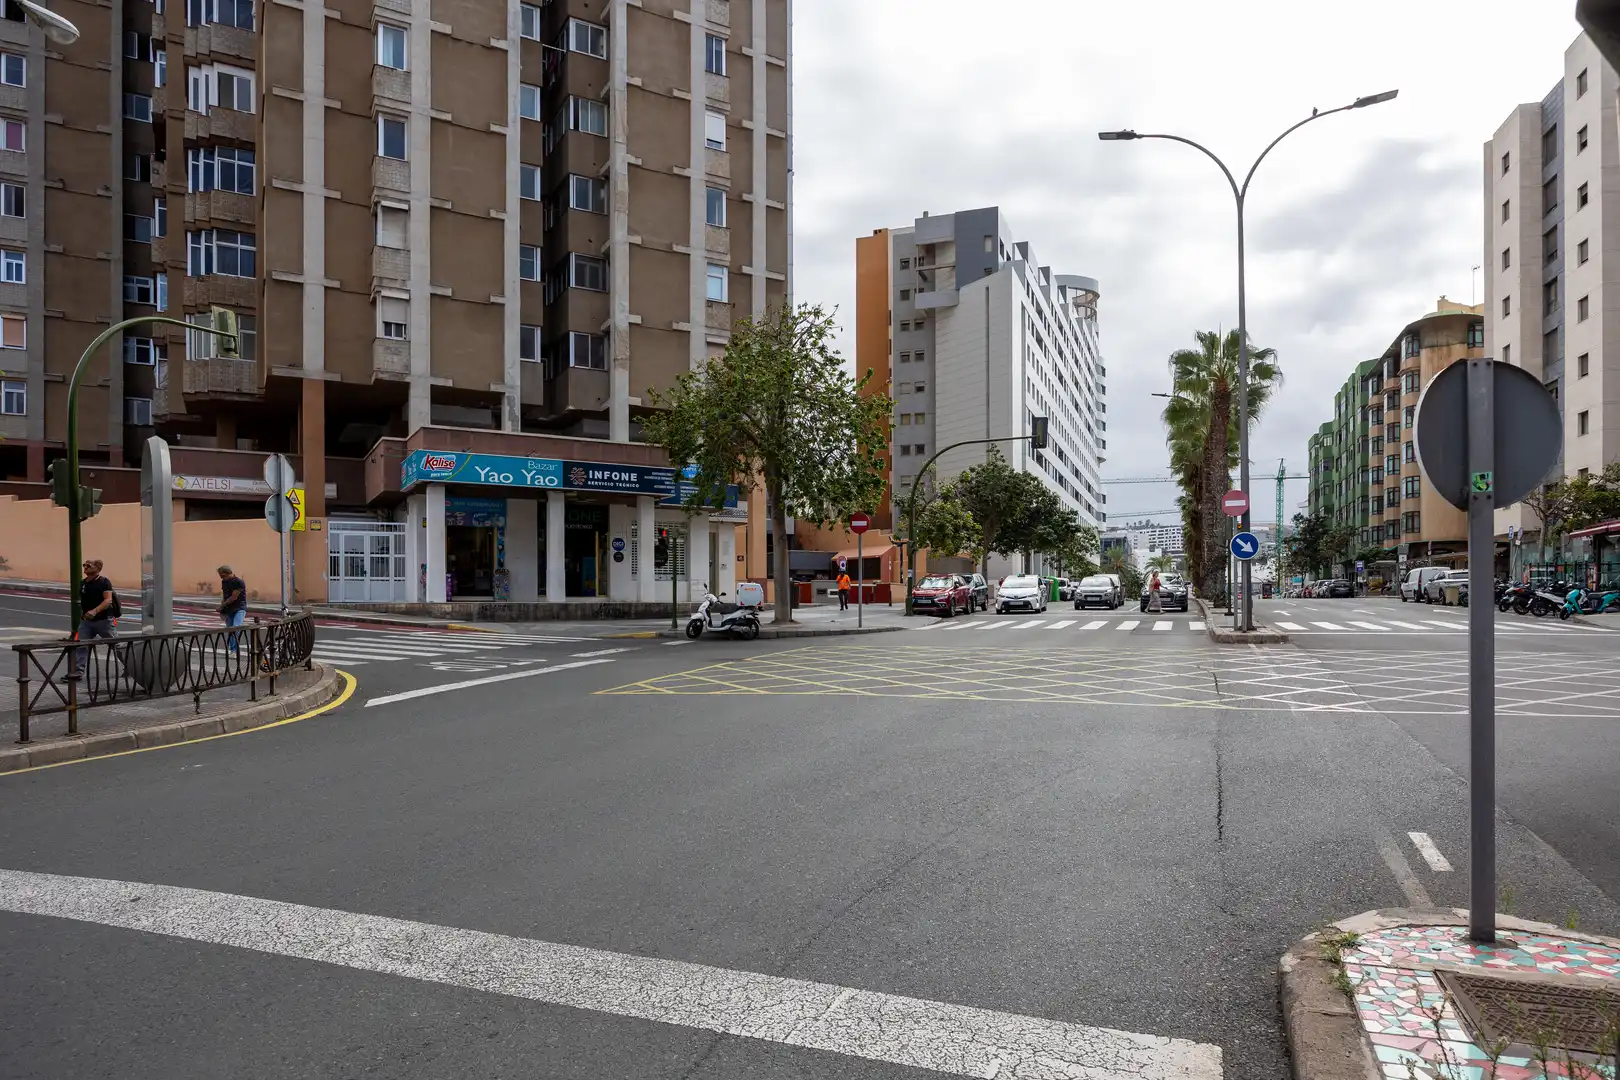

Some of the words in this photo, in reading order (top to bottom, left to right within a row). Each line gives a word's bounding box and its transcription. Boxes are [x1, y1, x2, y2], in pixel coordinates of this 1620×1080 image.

[423, 453, 456, 471] Kalise
[527, 460, 558, 471] Bazar
[474, 465, 514, 483] Yao
[521, 469, 558, 486] Yao
[588, 470, 638, 482] INFONE
[191, 477, 231, 490] ATELSI
